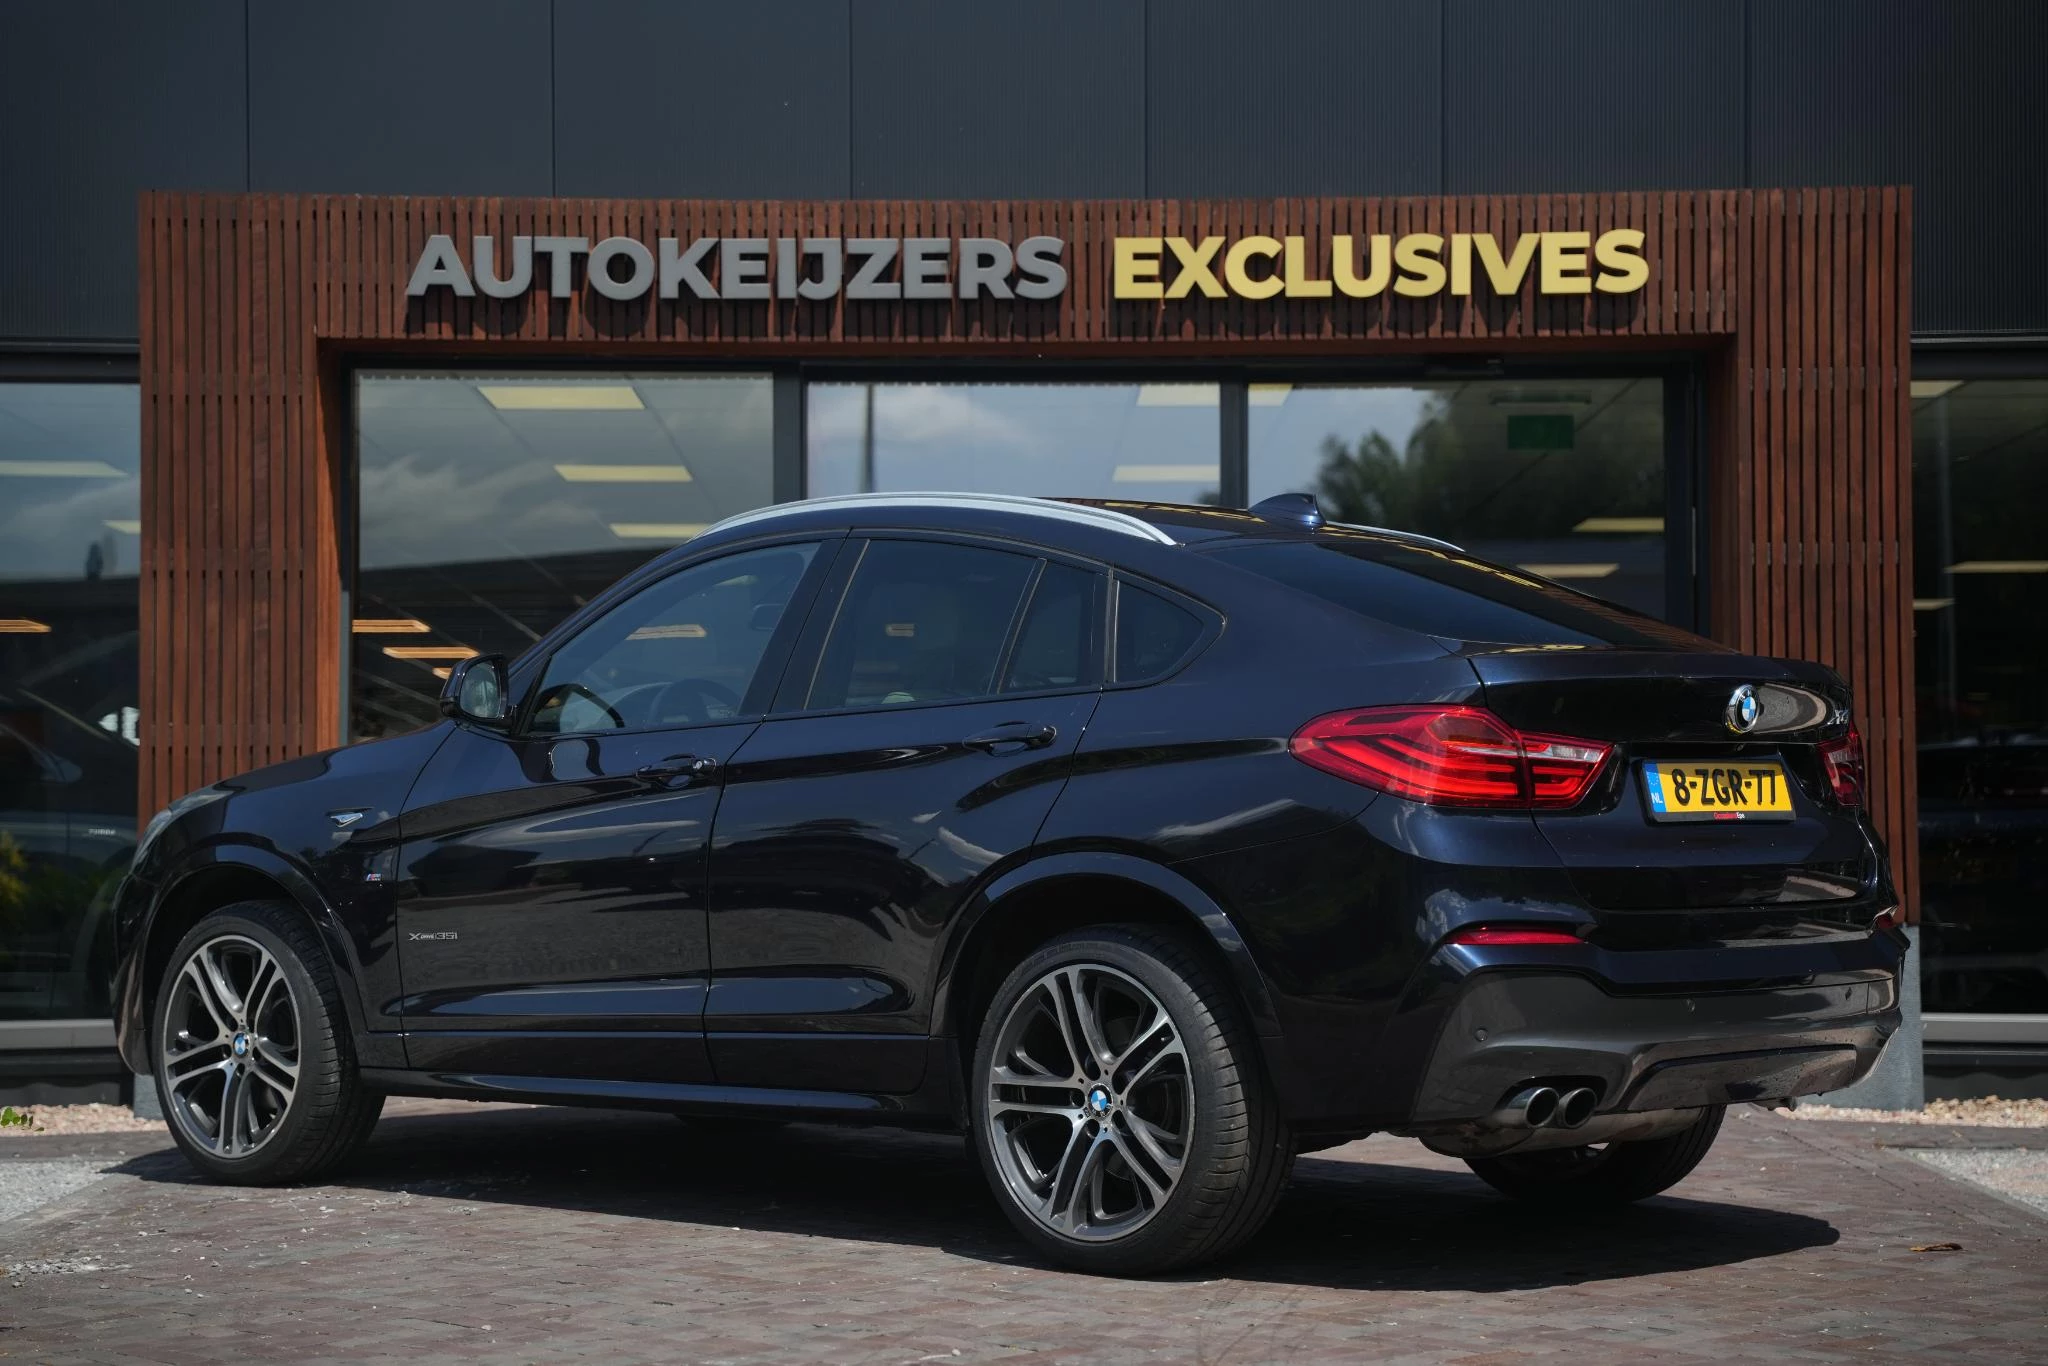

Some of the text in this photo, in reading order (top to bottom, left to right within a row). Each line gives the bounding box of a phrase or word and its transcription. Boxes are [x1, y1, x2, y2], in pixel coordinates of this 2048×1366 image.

[405, 228, 1650, 301] AUTOKEIJZERS EXCLUSIVES
[1650, 790, 1663, 804] NL
[1671, 768, 1776, 805] 8-ZGR-77
